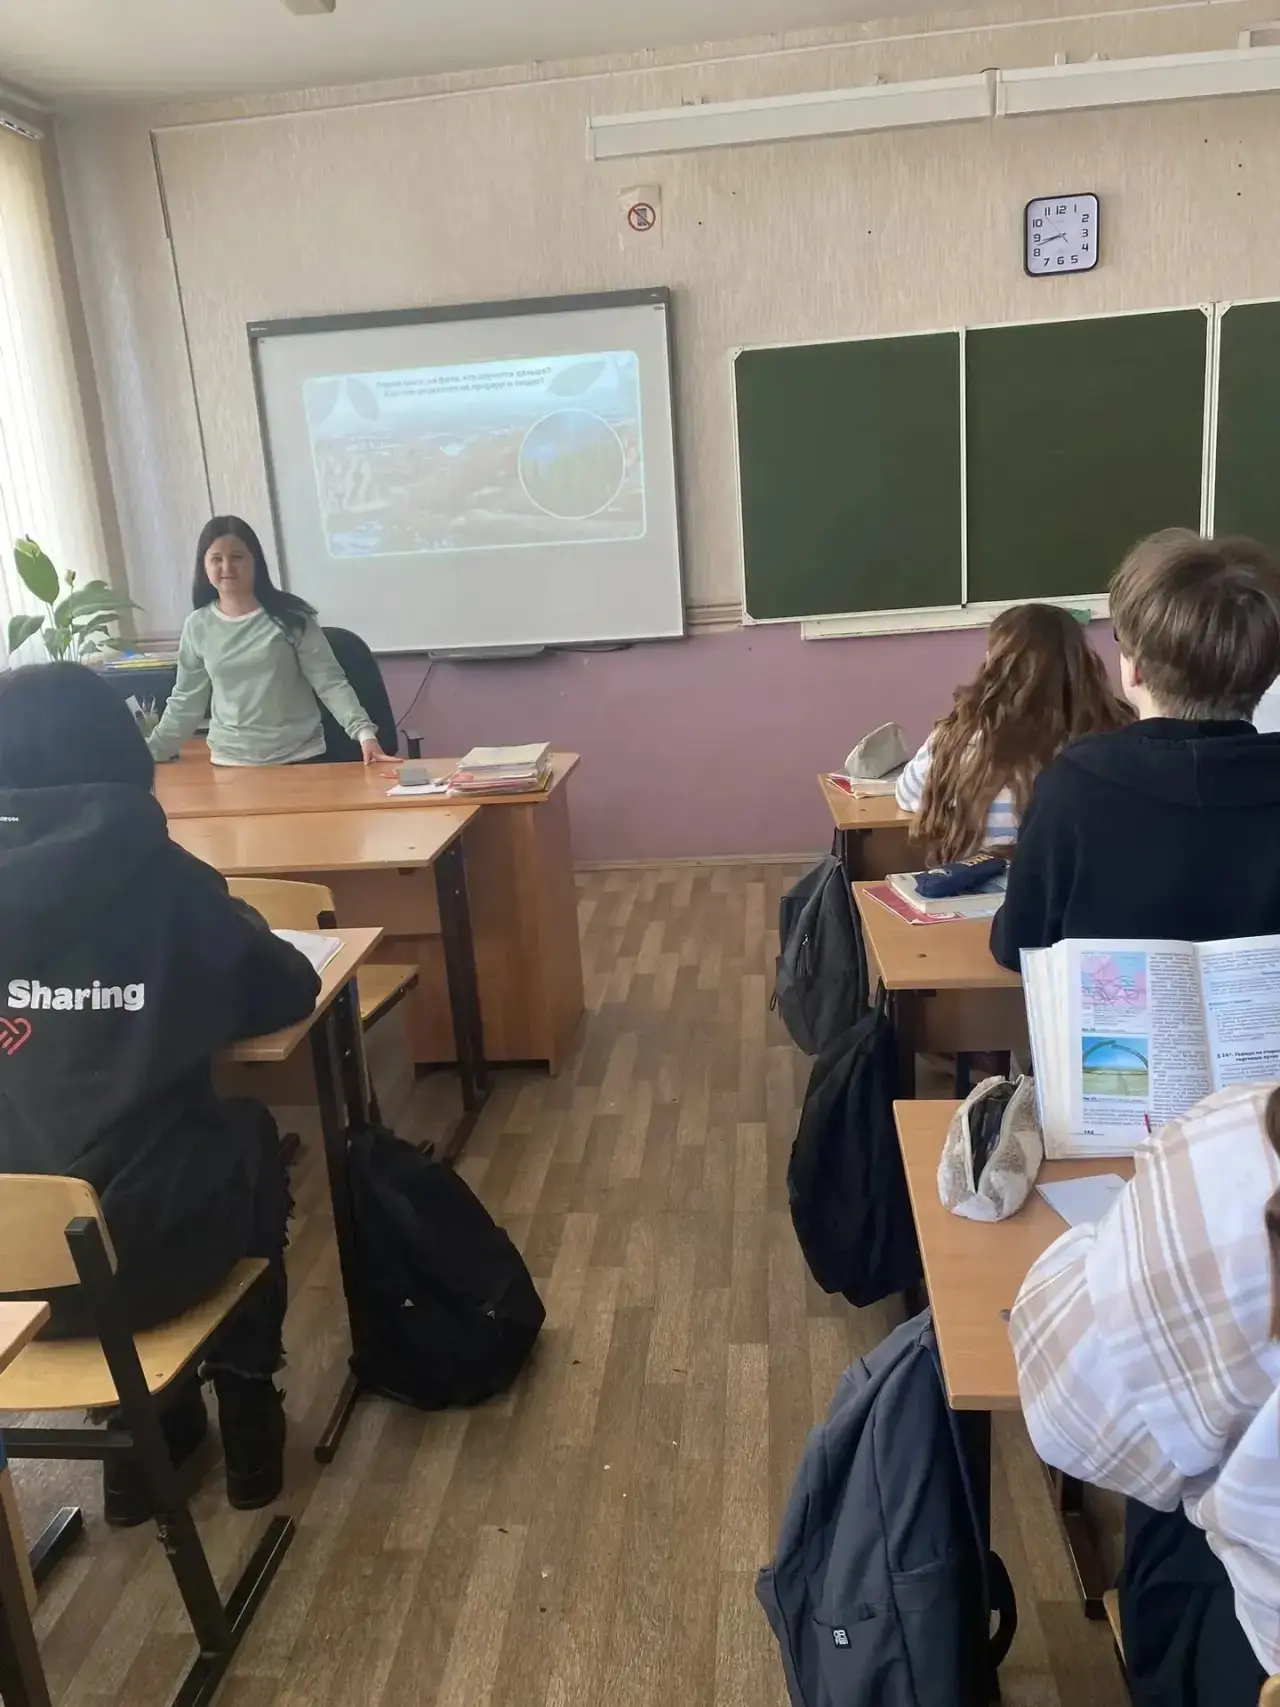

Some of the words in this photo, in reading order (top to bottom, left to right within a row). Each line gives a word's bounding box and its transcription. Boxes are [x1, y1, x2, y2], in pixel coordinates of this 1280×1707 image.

[1044, 206, 1051, 216] 11
[1056, 205, 1067, 215] 12
[1074, 204, 1077, 213] 1
[1081, 213, 1090, 223] 2
[1032, 219, 1043, 228] 10
[1033, 234, 1041, 242] 9
[1081, 228, 1089, 238] 3
[1033, 248, 1041, 257] 8
[1081, 243, 1089, 252] 4
[1043, 257, 1051, 267] 7
[1057, 256, 1065, 265] 6
[1070, 254, 1079, 264] 5
[7, 979, 145, 1012] Sharing
